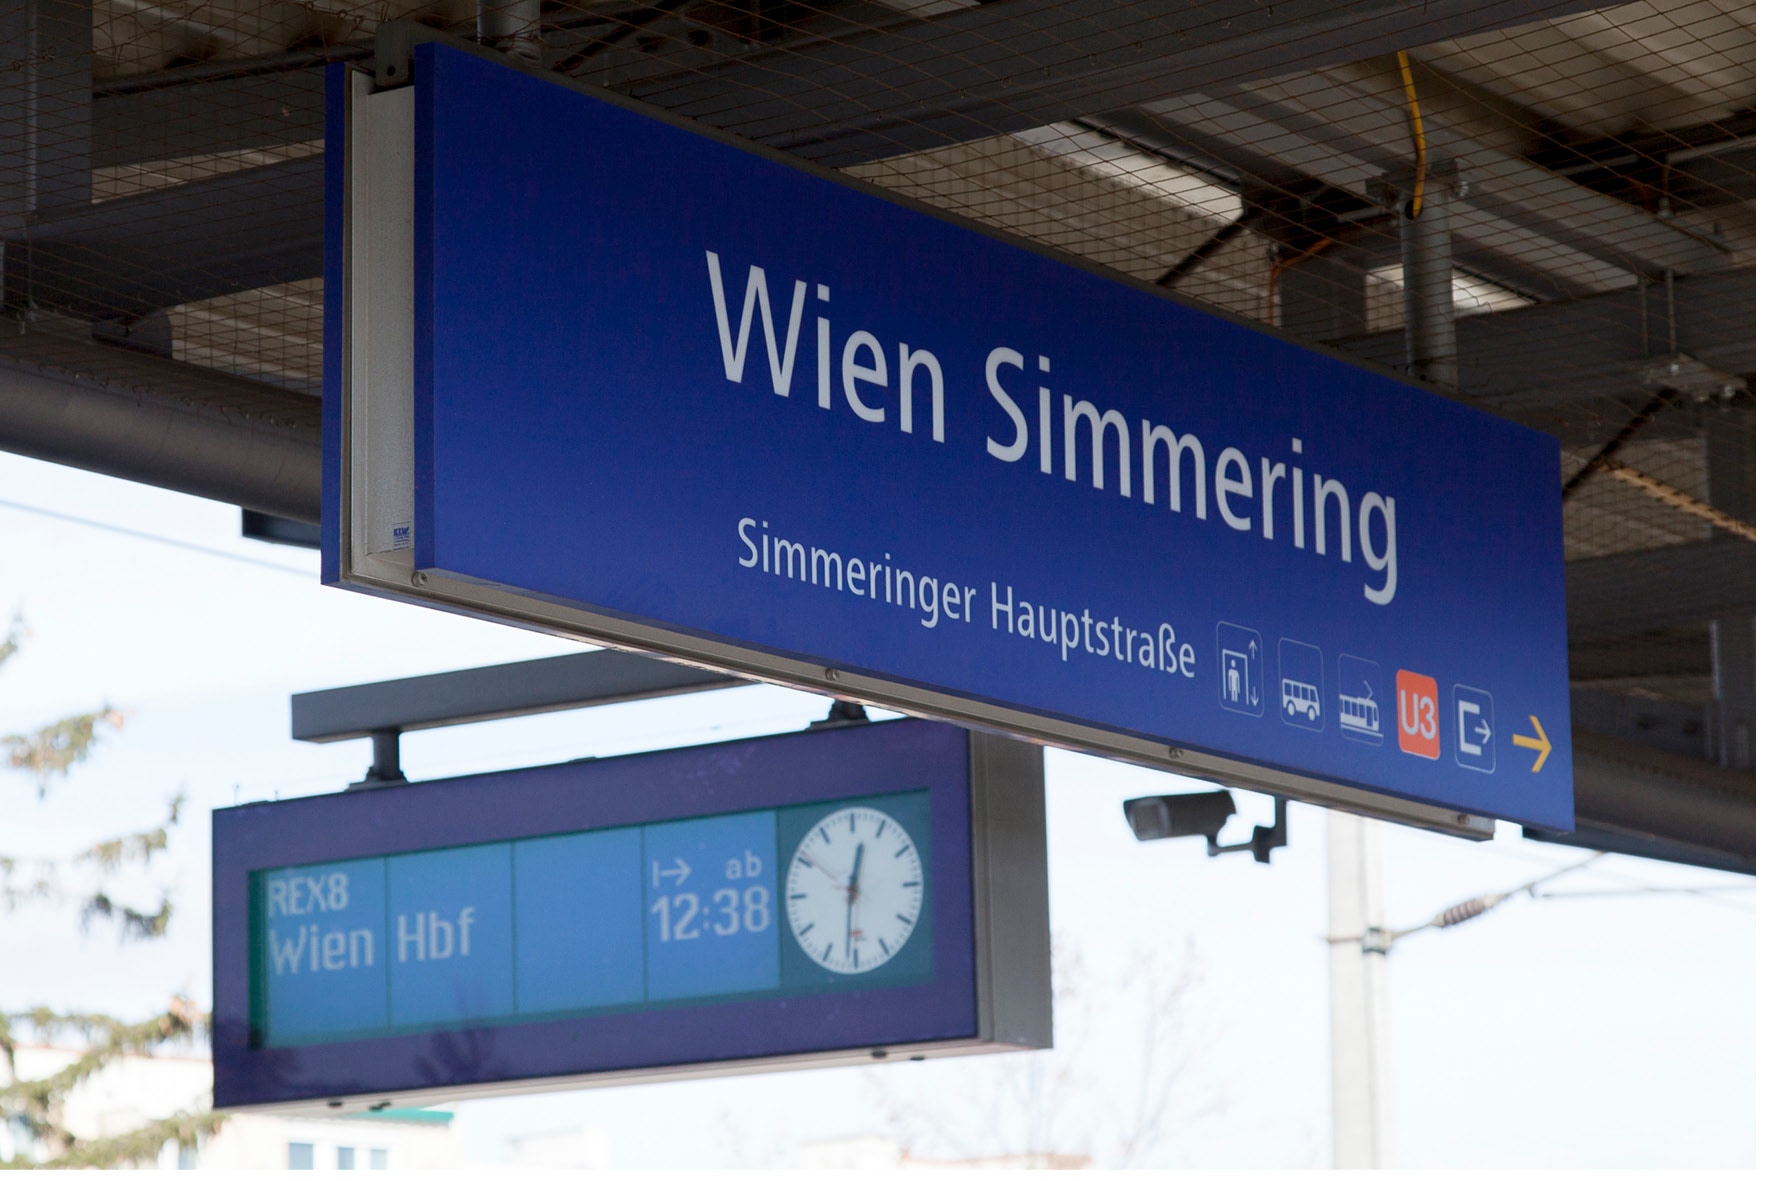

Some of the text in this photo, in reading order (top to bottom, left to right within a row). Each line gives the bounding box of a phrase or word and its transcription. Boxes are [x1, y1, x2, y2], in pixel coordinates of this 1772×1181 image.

[707, 251, 1397, 606] Wien Simmering
[738, 517, 1196, 679] Simmeringer Hauptstraße
[1400, 690, 1437, 741] U3
[725, 850, 762, 880] ab
[267, 872, 349, 917] REX8
[651, 884, 770, 942] 12:38
[268, 907, 476, 976] Wien Hbf
